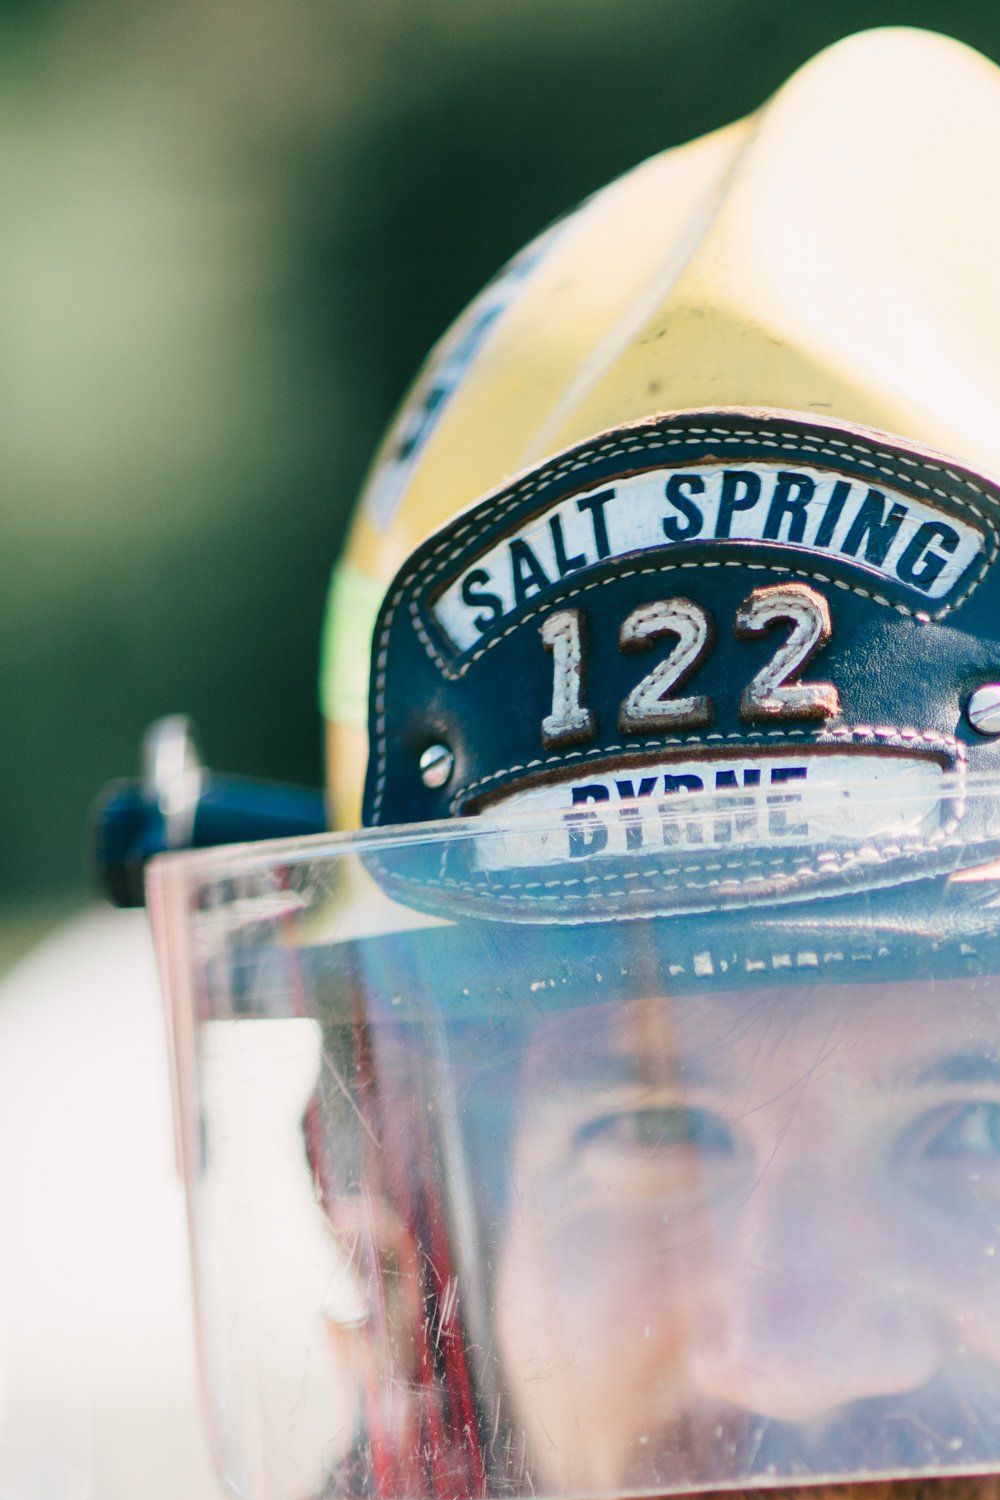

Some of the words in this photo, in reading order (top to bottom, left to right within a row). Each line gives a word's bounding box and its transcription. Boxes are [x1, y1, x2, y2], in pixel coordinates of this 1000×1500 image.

[461, 489, 619, 635] SALT
[662, 470, 963, 588] SPRING
[540, 582, 842, 749] 122
[562, 767, 808, 858] BYRNE
